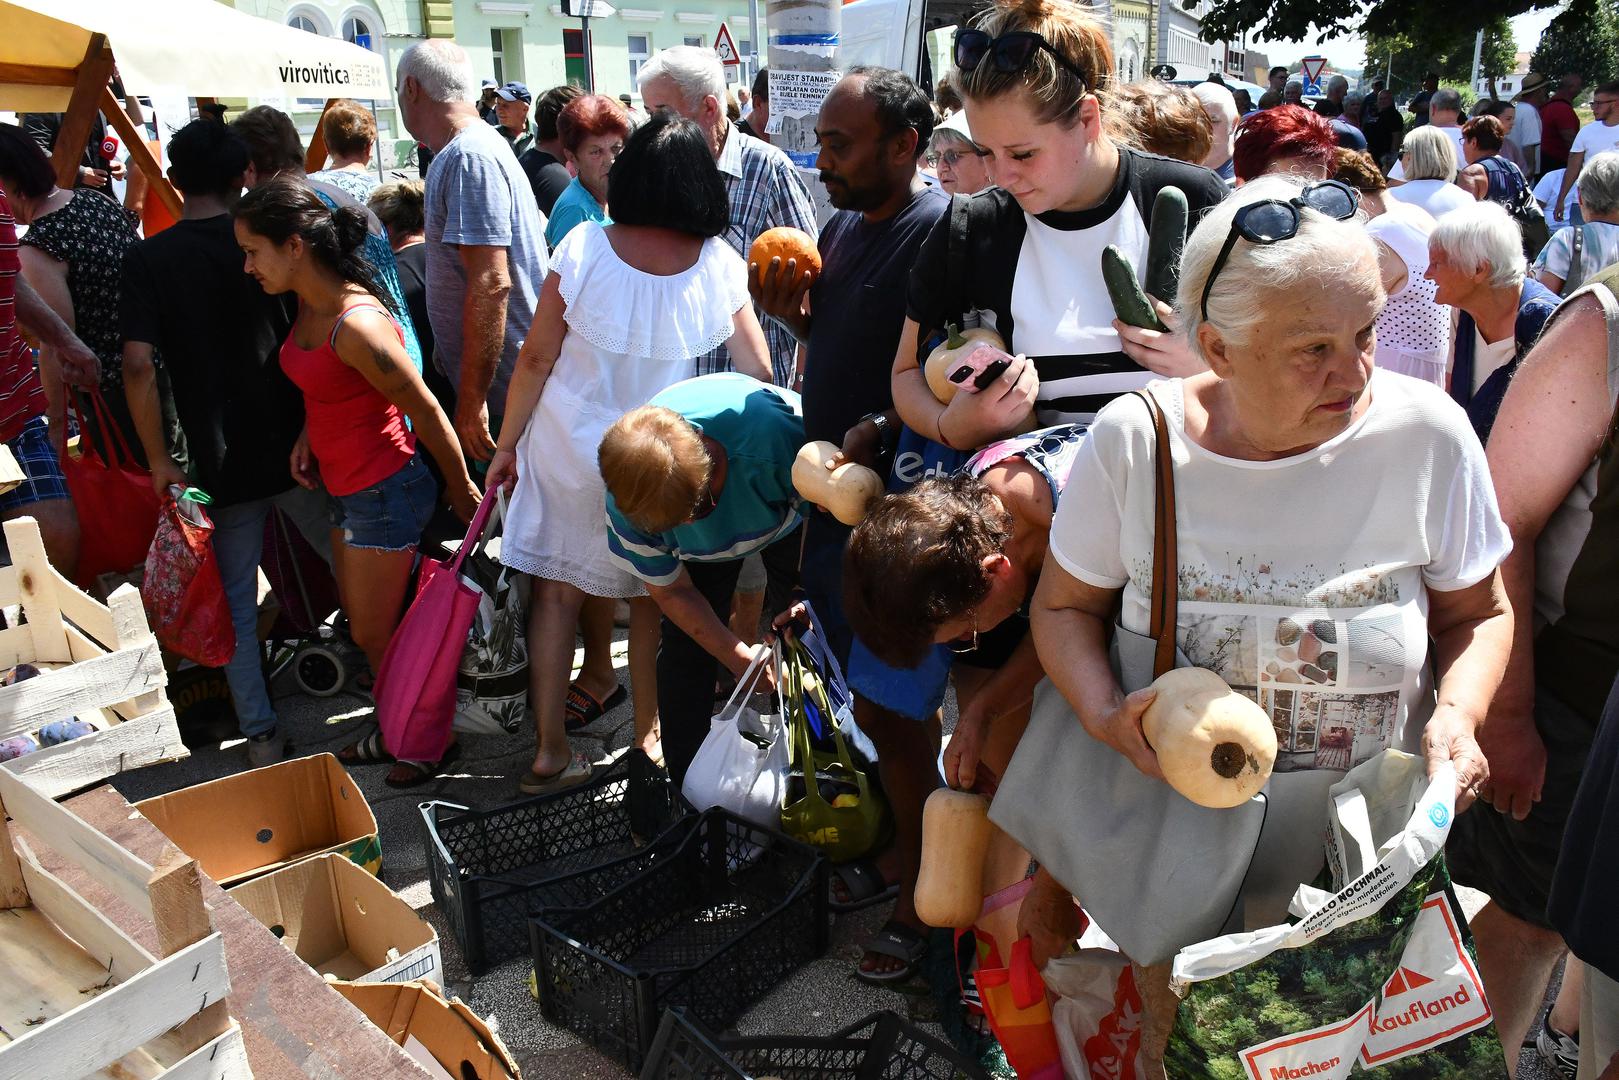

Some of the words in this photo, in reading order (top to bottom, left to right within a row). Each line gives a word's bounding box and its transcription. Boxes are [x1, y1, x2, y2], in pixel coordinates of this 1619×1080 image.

[278, 60, 350, 84] virovitica
[1337, 863, 1391, 903] NOCHMAL.
[1356, 871, 1395, 902] mindestens
[1336, 901, 1368, 918] eigenen
[1368, 983, 1471, 1036] Kaufland
[1270, 1056, 1340, 1080] Machen
